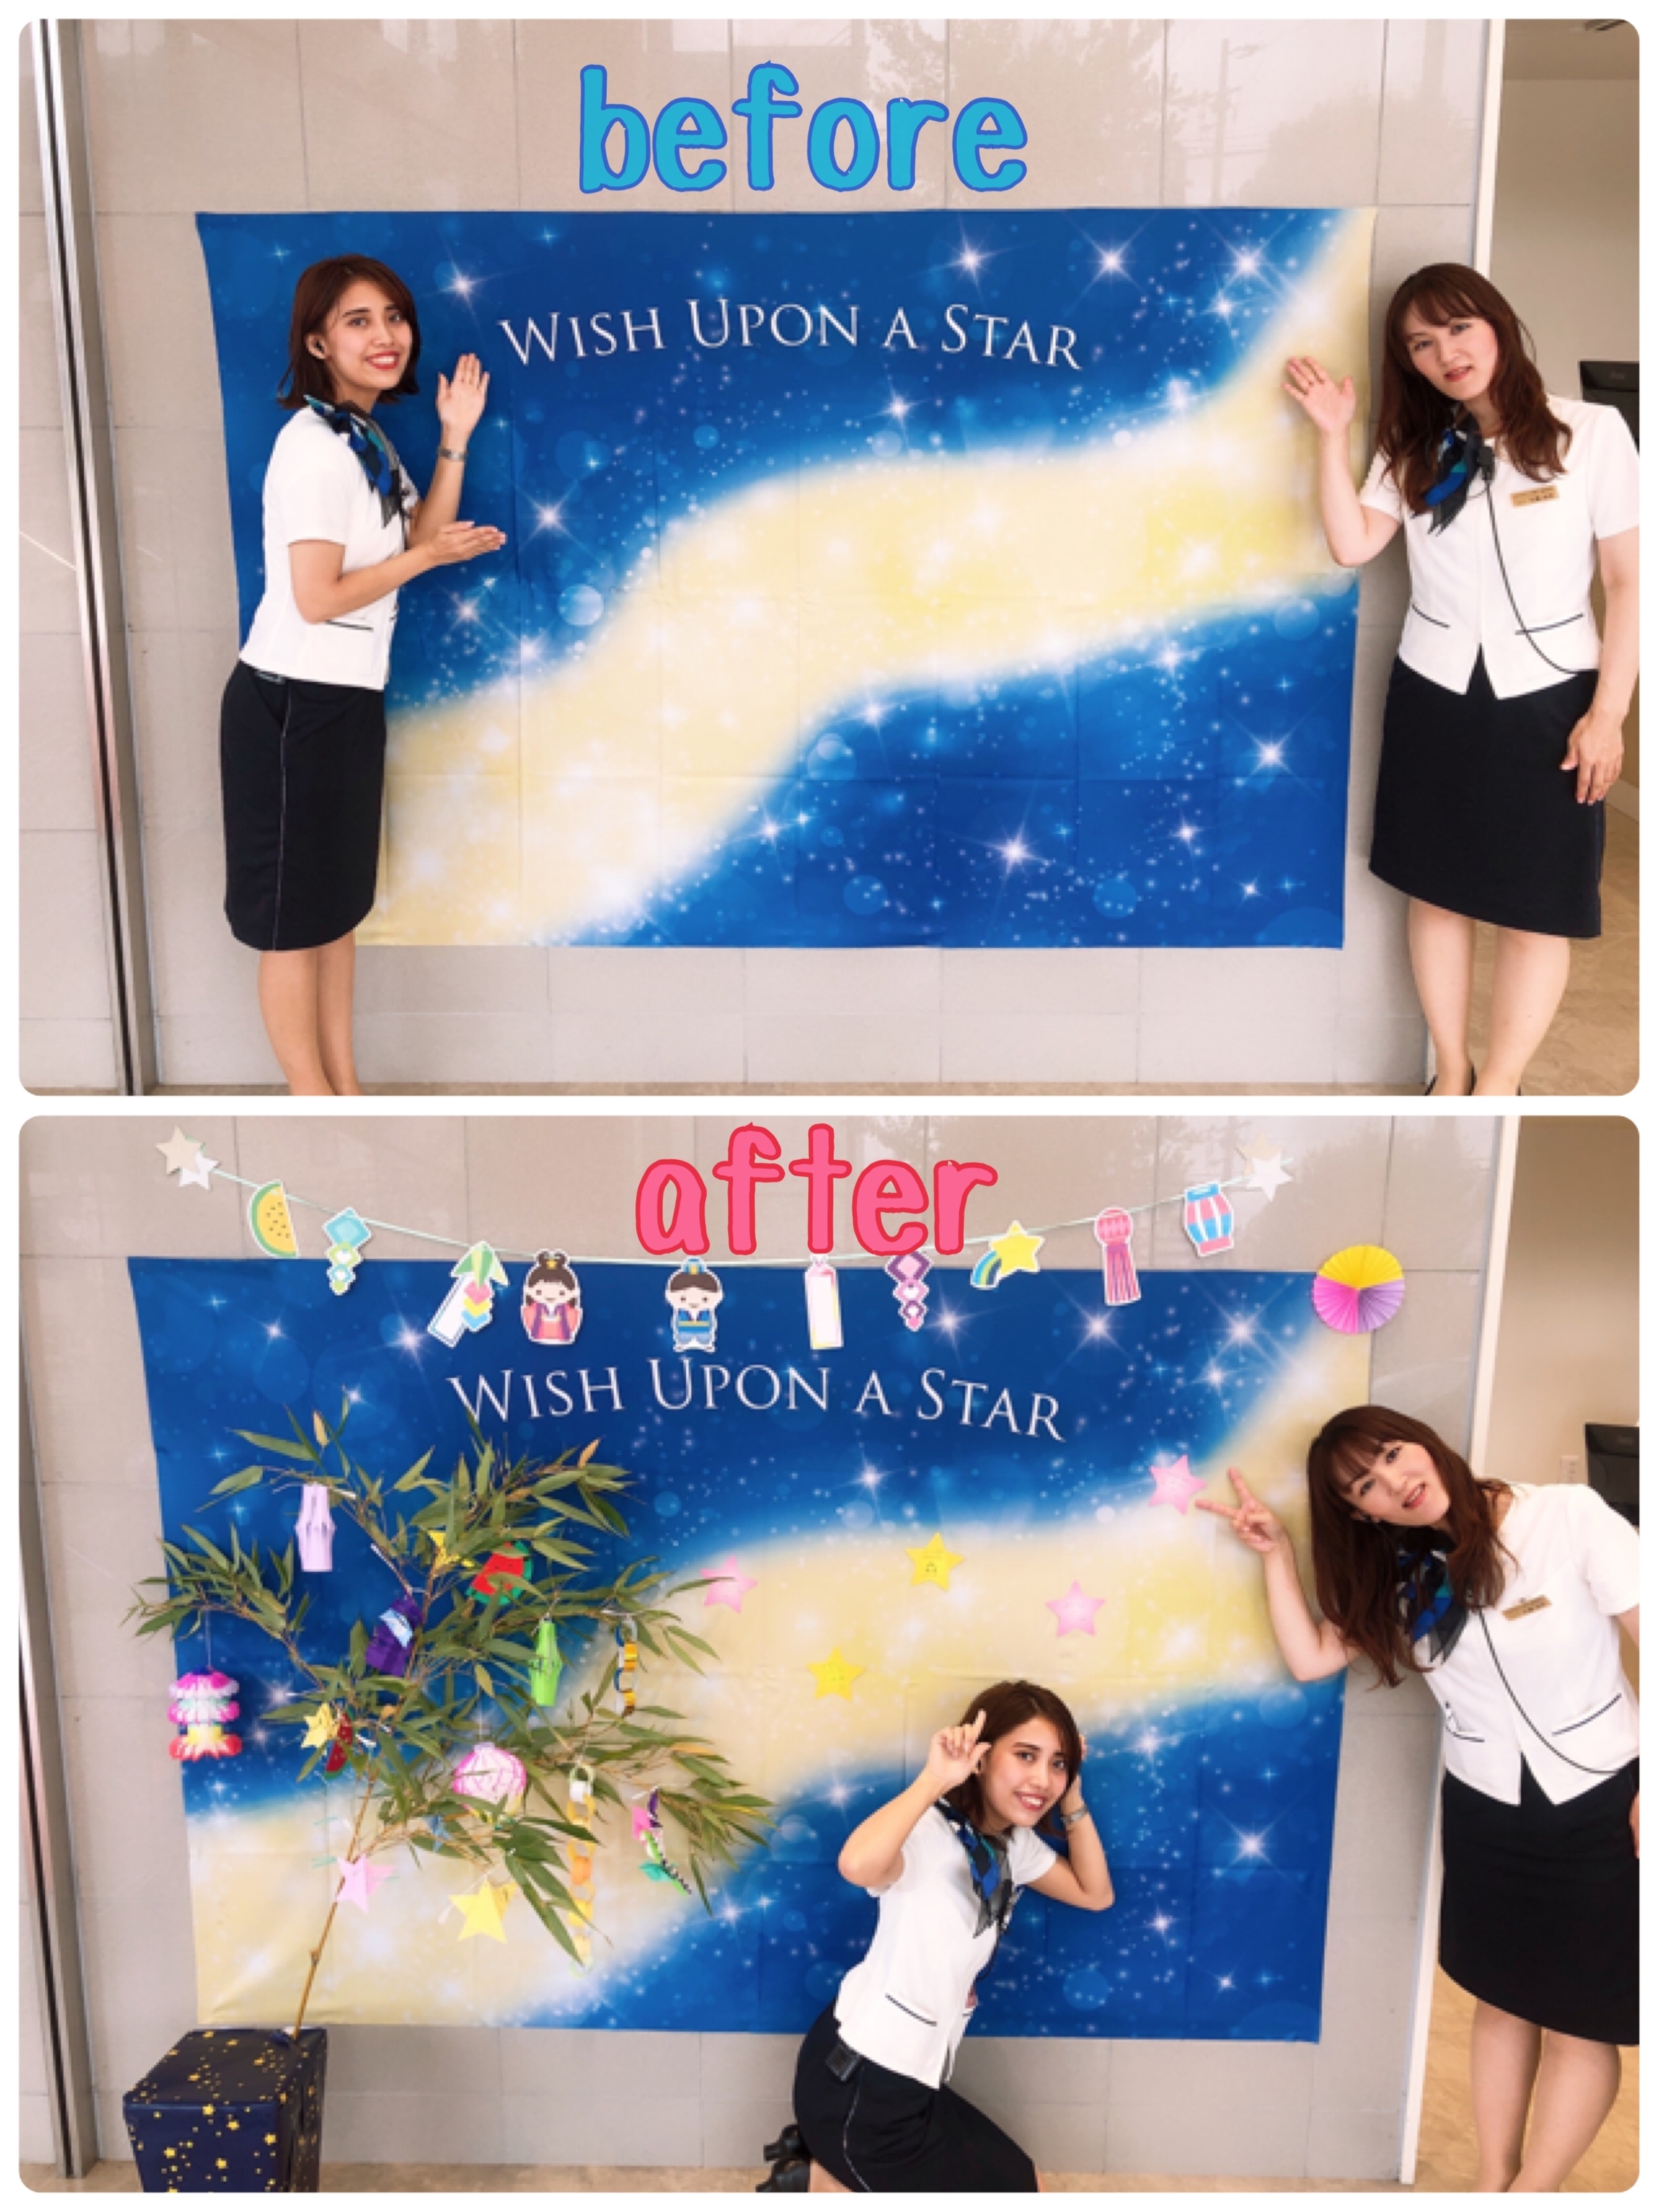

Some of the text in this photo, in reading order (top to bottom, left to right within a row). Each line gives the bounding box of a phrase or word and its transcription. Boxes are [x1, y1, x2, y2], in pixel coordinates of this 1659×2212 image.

[498, 299, 1083, 370] WISH UPON A STAR
[446, 1356, 1066, 1442] WISH UPON A STAR
